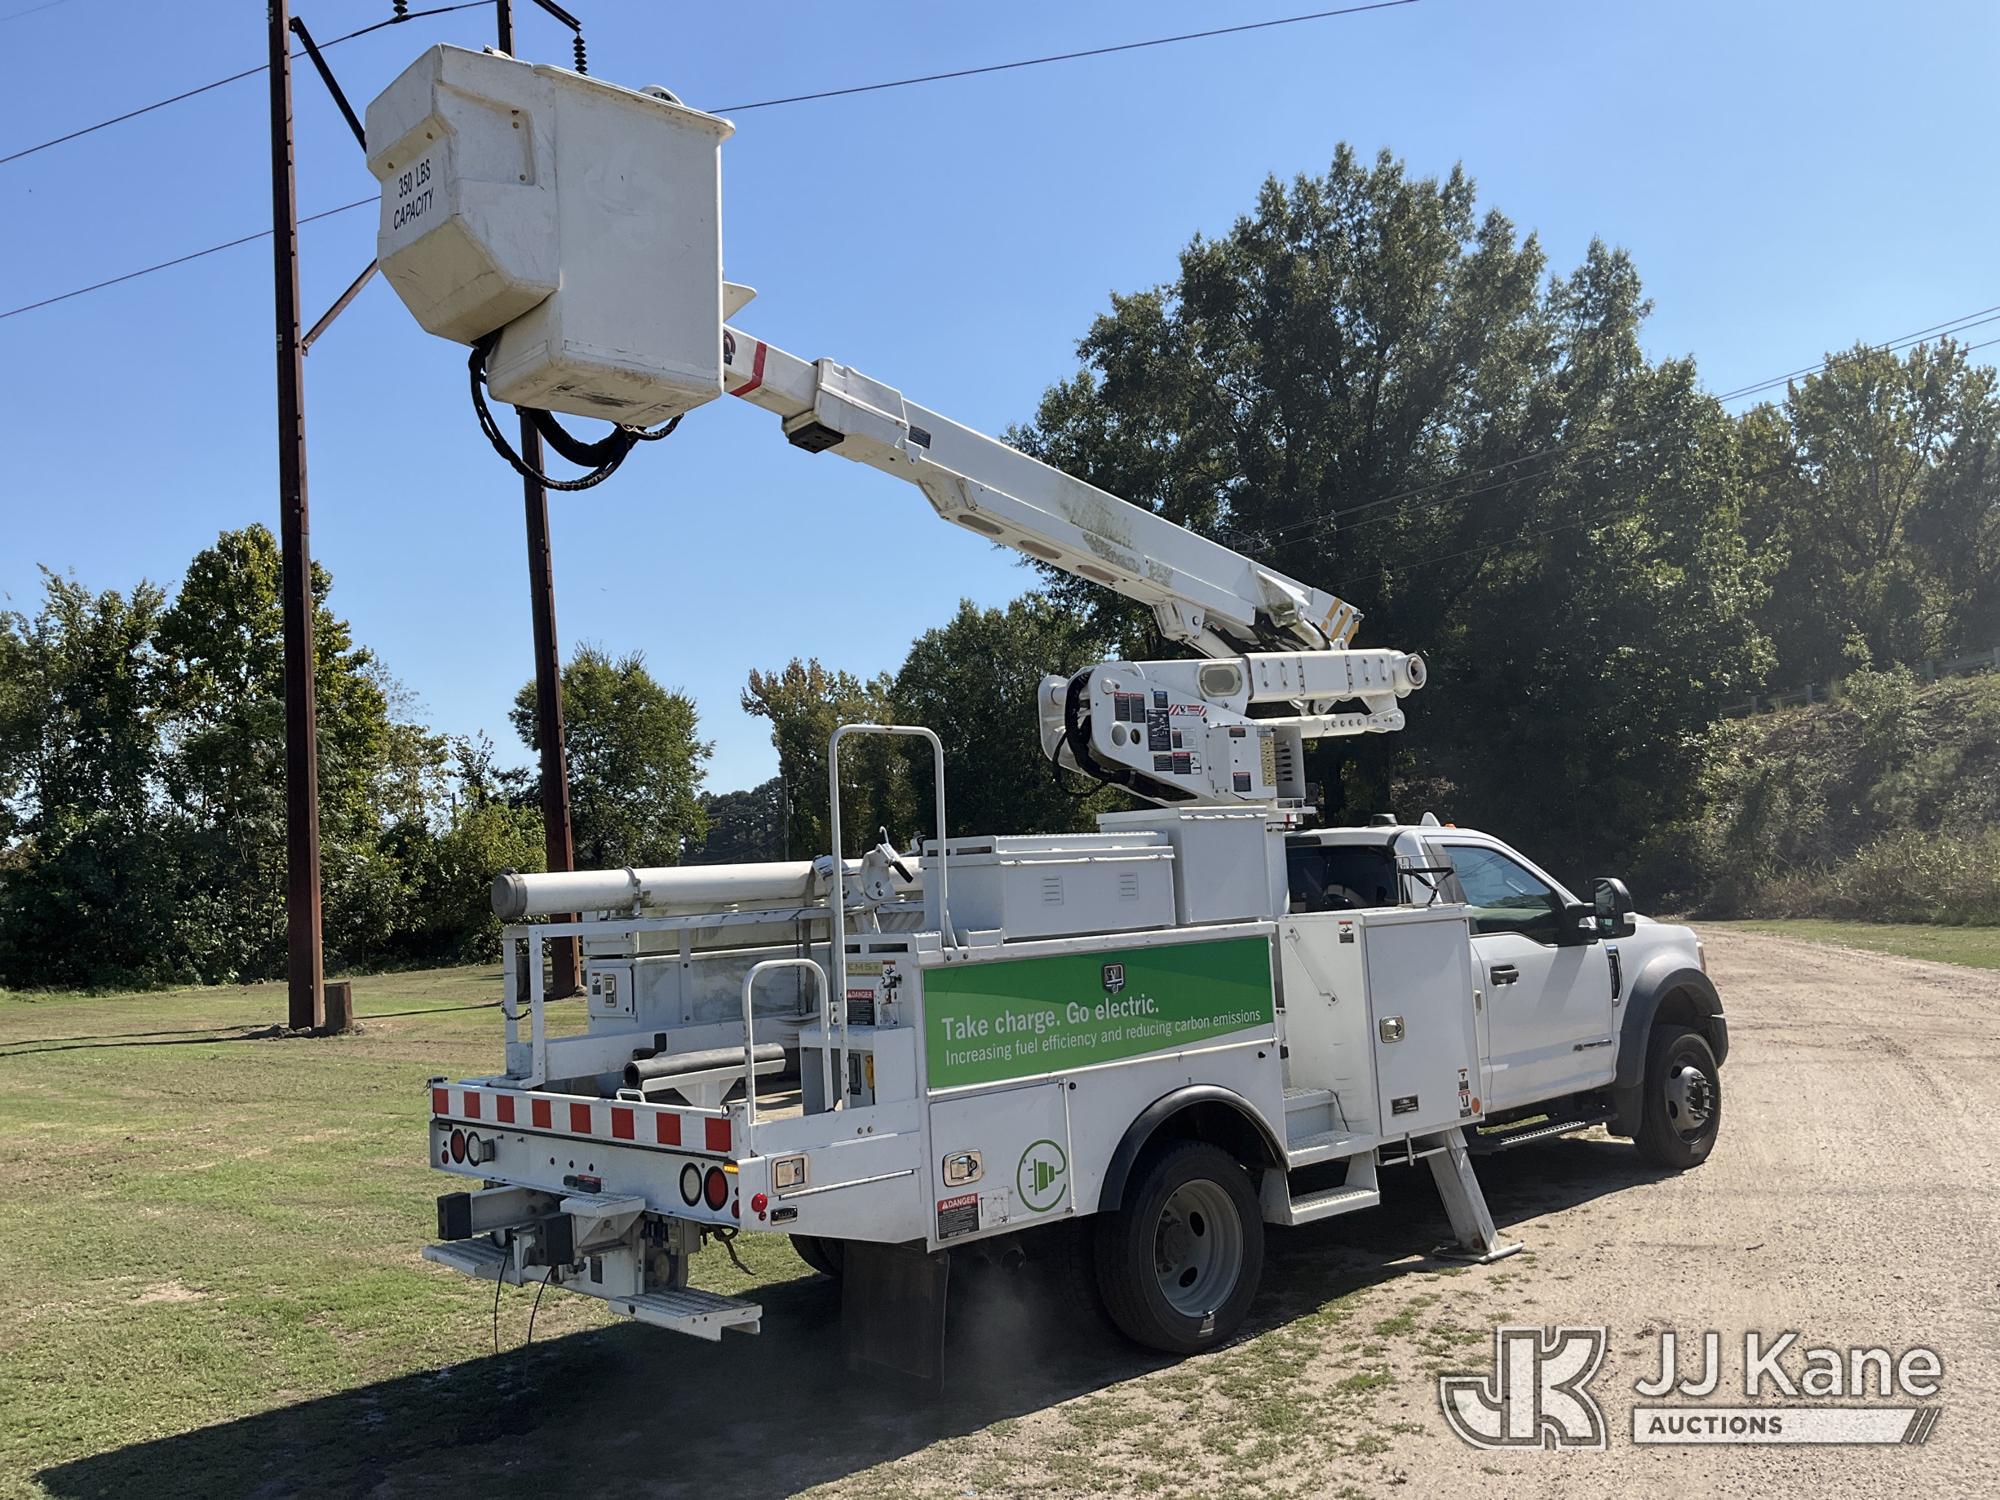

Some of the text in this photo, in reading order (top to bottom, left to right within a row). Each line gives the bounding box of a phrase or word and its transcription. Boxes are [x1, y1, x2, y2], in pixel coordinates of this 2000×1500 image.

[398, 158, 431, 198] 350 LBS
[393, 187, 434, 230] CAPACITY
[941, 993, 1159, 1040] Take charge. Go electric.
[946, 1008, 1261, 1066] Increasing fuel efficiency and reducing carbon emissions
[948, 1195, 976, 1208] DANGER
